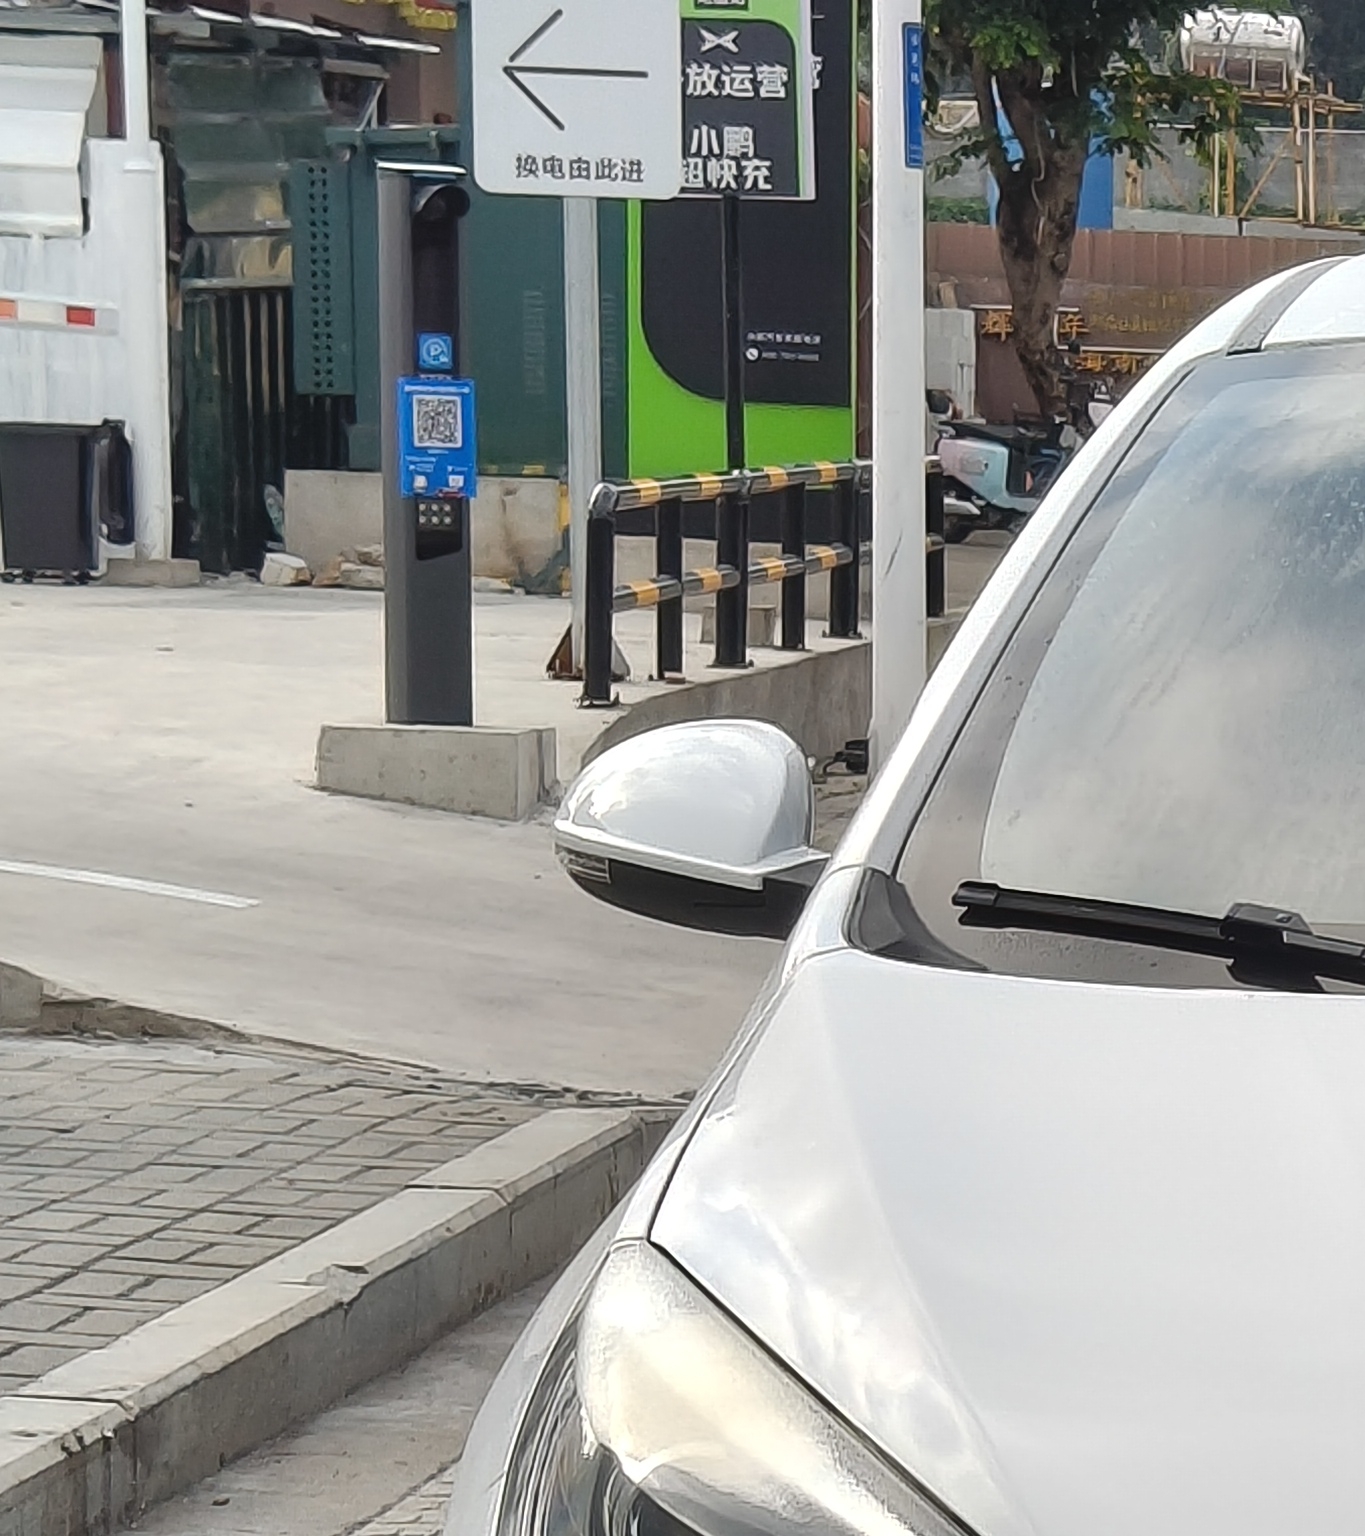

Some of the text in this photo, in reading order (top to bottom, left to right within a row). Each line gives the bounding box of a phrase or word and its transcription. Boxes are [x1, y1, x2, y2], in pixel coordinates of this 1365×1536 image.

[681, 63, 789, 98] 放运营
[515, 153, 645, 182] 换电由此进
